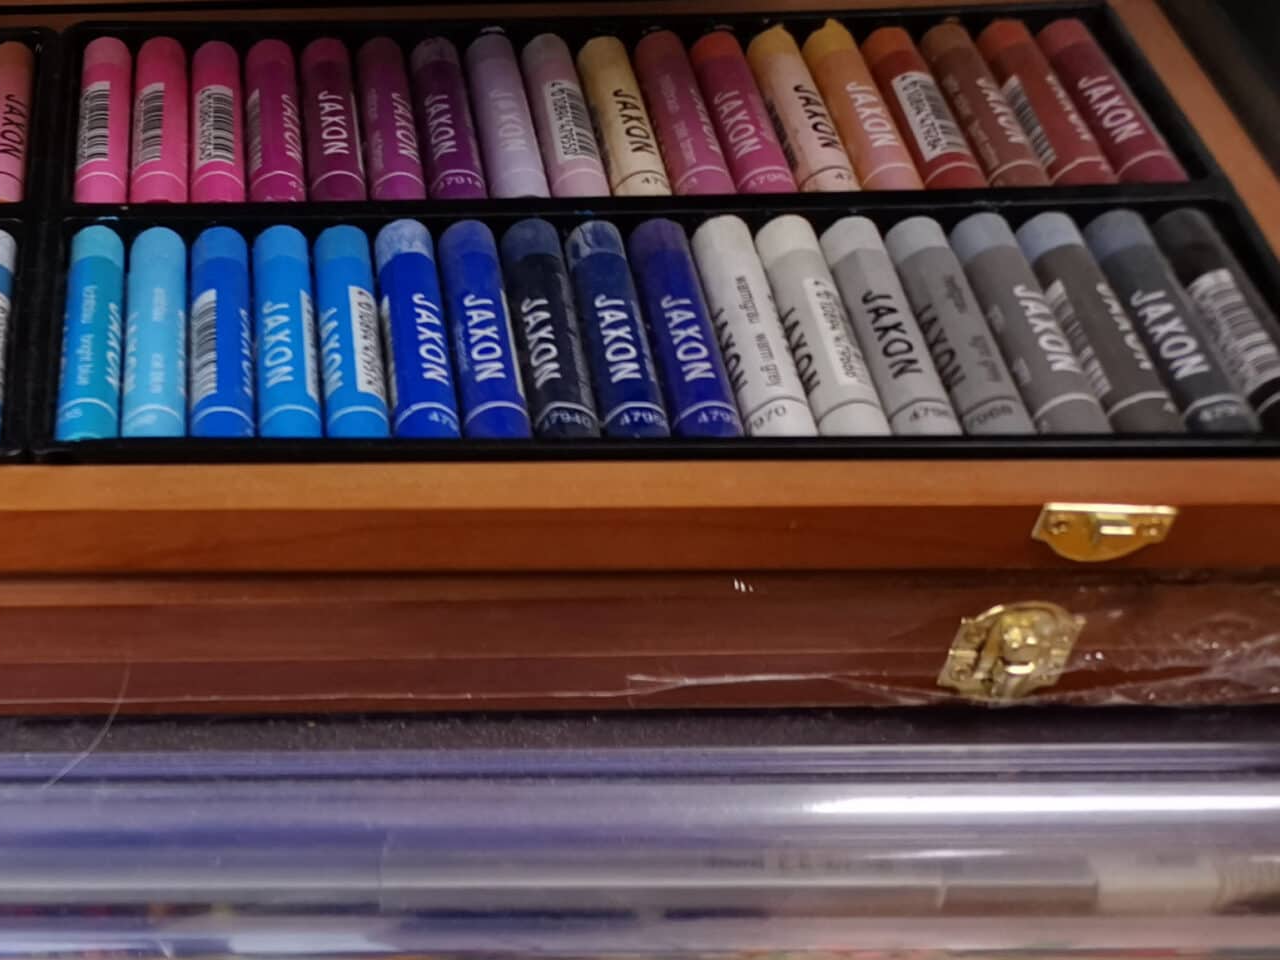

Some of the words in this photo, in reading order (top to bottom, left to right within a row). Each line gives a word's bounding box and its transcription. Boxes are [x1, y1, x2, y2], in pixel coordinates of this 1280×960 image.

[317, 90, 351, 156] JAXON
[391, 92, 420, 164] JAXON
[425, 93, 458, 160] JAXON
[612, 88, 656, 154] JAXON
[713, 90, 764, 159] JAXON
[845, 81, 900, 148] JAXON
[1076, 75, 1146, 144] JAXON
[263, 300, 294, 388] JAXON
[412, 293, 449, 385] JAXON
[463, 294, 506, 383] JAXON
[521, 297, 563, 390] JAXON
[594, 293, 643, 384] JAXON
[660, 294, 716, 383] JAXON
[860, 290, 923, 379] JAXON
[921, 303, 967, 387] JAXON
[1013, 283, 1084, 374] JAXON
[1130, 288, 1211, 380] JAXON
